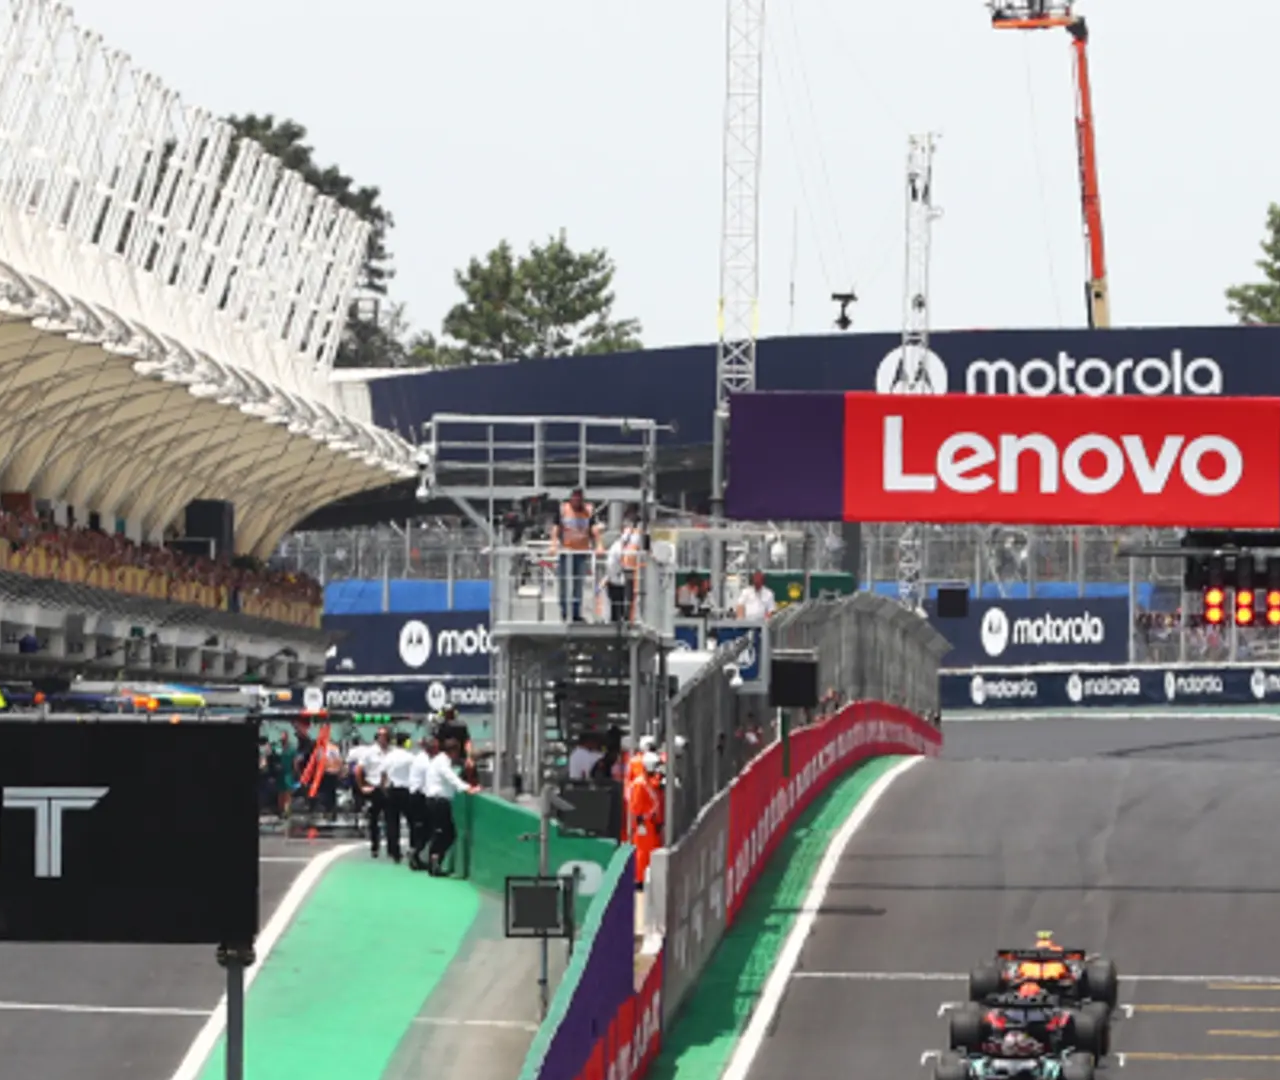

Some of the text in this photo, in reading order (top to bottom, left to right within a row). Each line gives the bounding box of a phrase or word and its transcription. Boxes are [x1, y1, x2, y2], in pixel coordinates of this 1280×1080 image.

[966, 349, 1224, 397] motorola
[883, 415, 1244, 496] Lenovo
[1013, 611, 1104, 644] motorola
